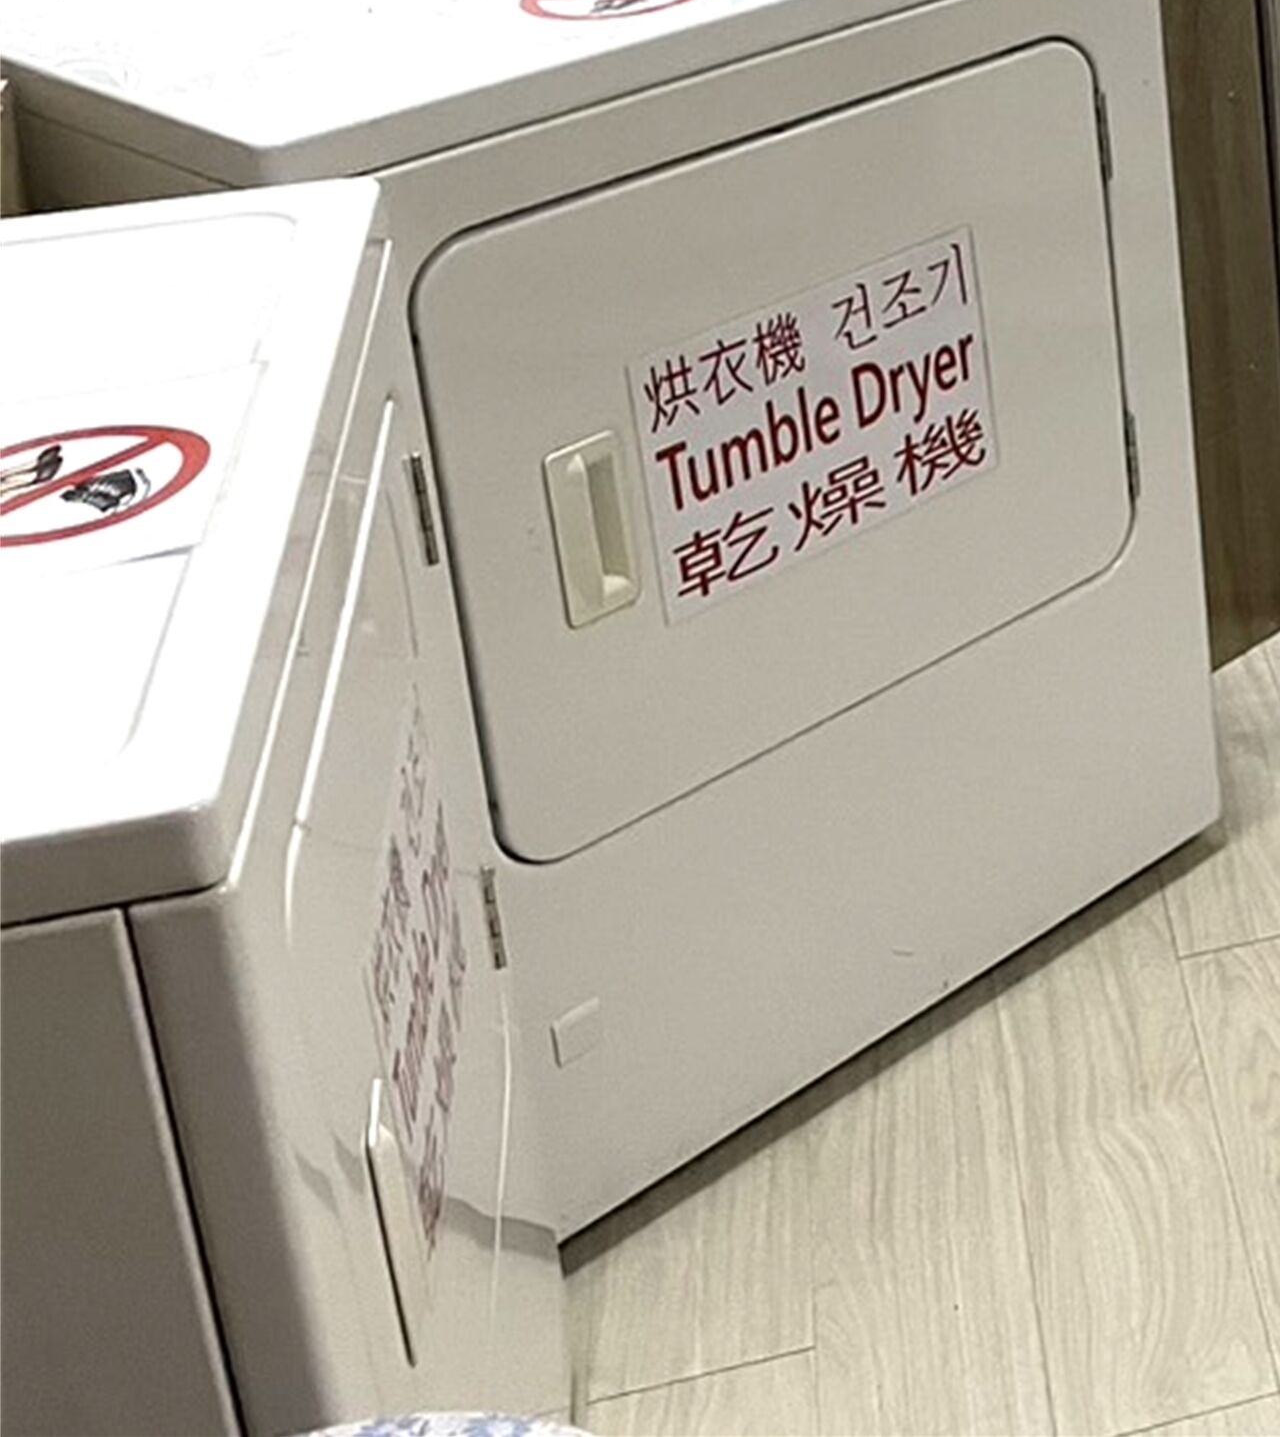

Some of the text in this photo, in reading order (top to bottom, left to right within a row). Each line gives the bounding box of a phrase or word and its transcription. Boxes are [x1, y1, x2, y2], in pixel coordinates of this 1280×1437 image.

[643, 242, 969, 434] 烘衣機 건조기
[656, 333, 974, 511] Tumble Dryer
[673, 408, 987, 598] 乾燥機
